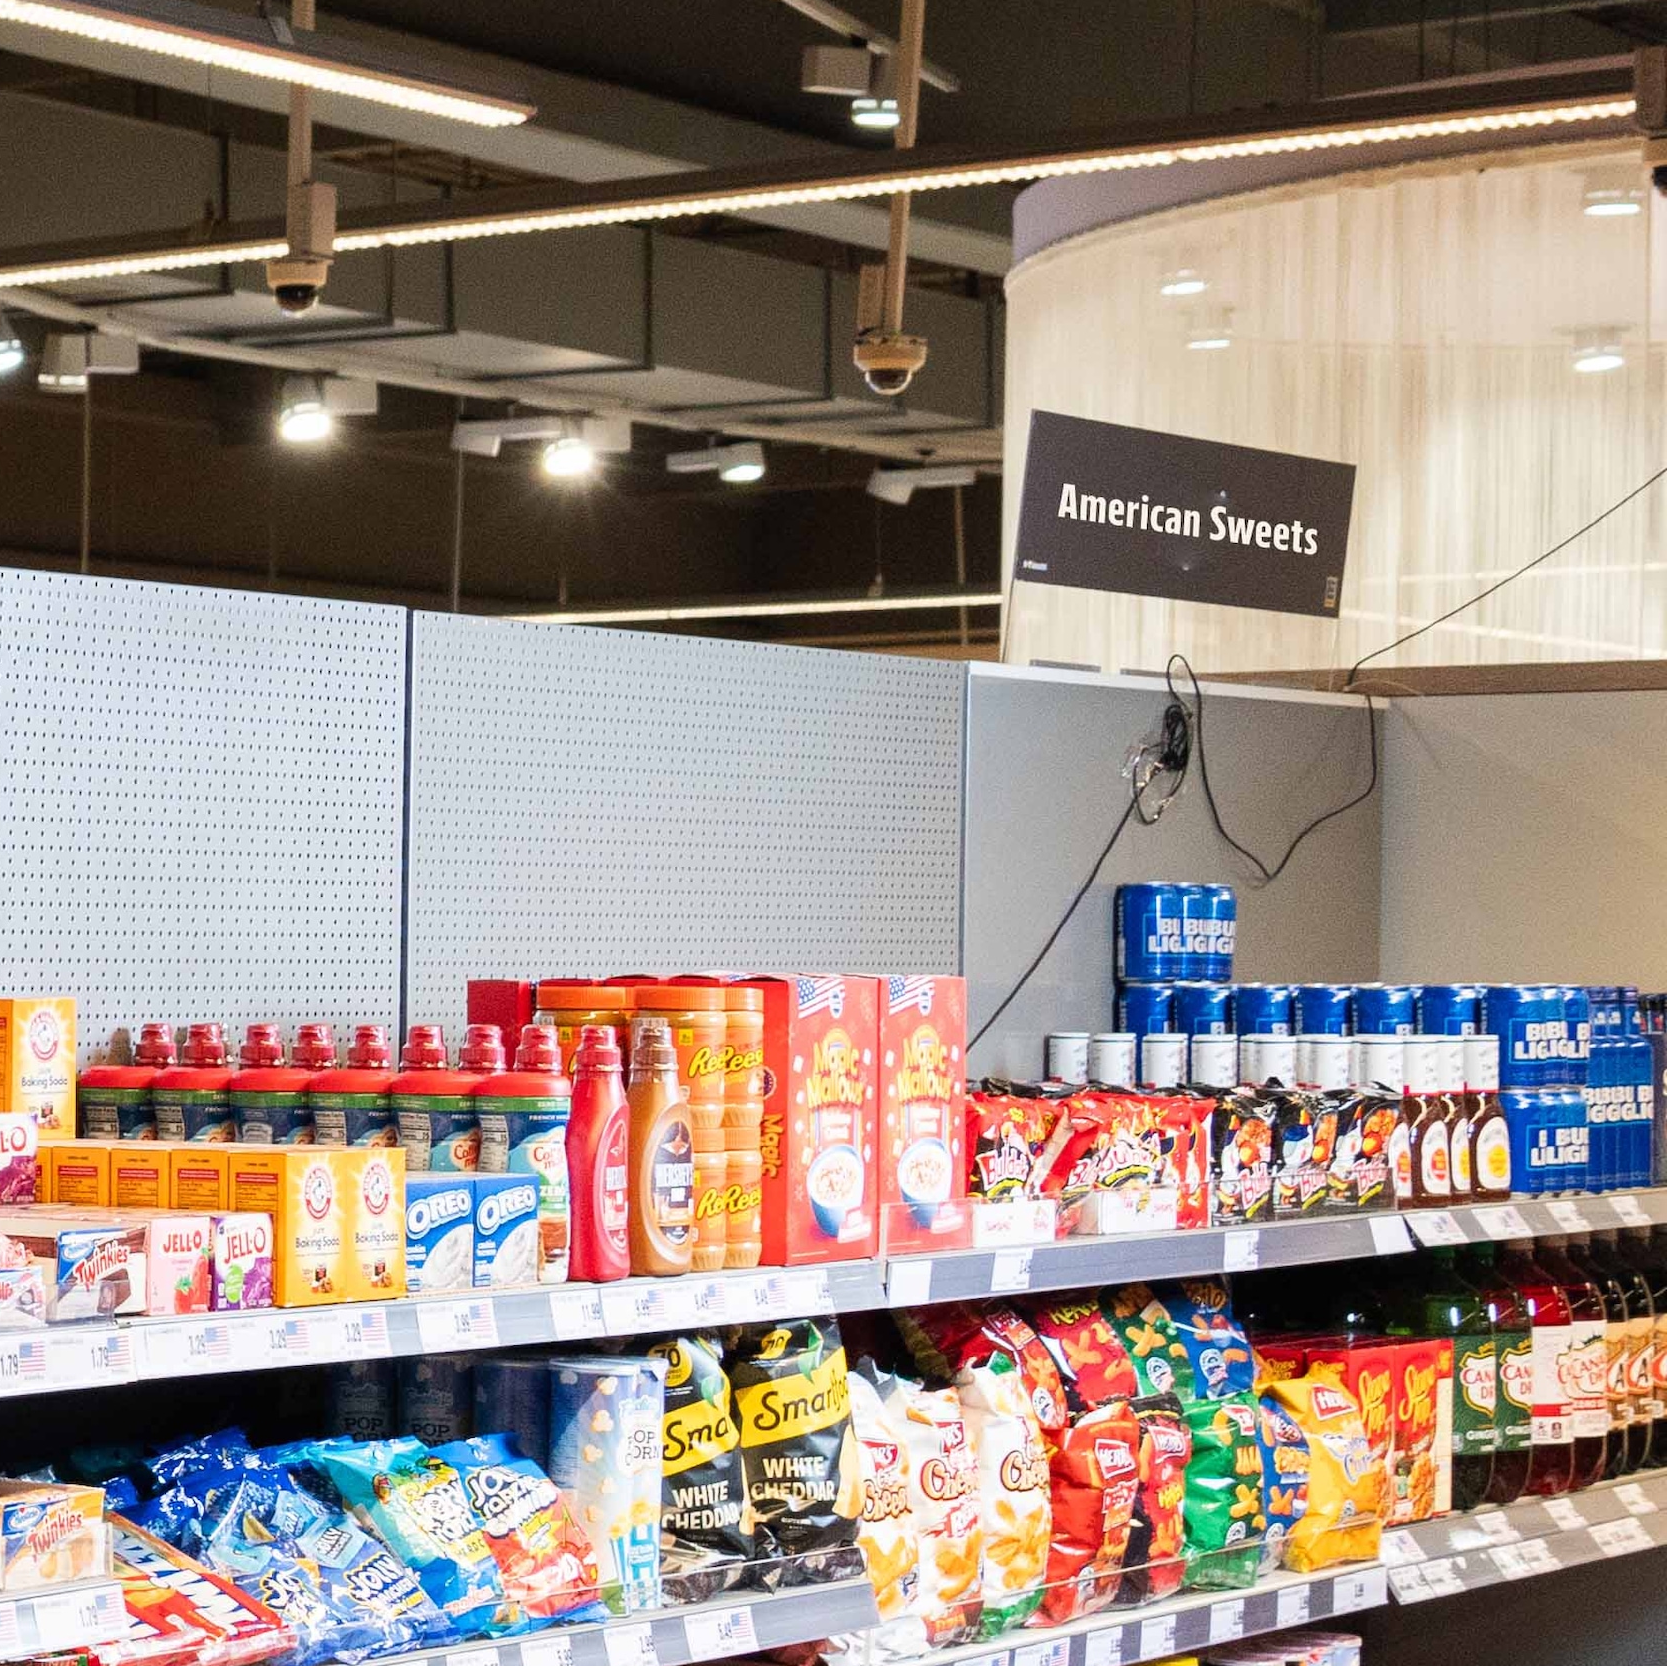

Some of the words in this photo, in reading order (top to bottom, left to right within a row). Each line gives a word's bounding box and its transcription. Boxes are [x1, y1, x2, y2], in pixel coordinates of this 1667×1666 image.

[1058, 484, 1201, 538] American
[1209, 506, 1319, 556] Sweets
[406, 1192, 470, 1237] OREO
[477, 1187, 536, 1232] OREO
[762, 1456, 825, 1481] WHITE
[673, 1481, 728, 1509] WHITE
[752, 1480, 835, 1503] CHEDDAR
